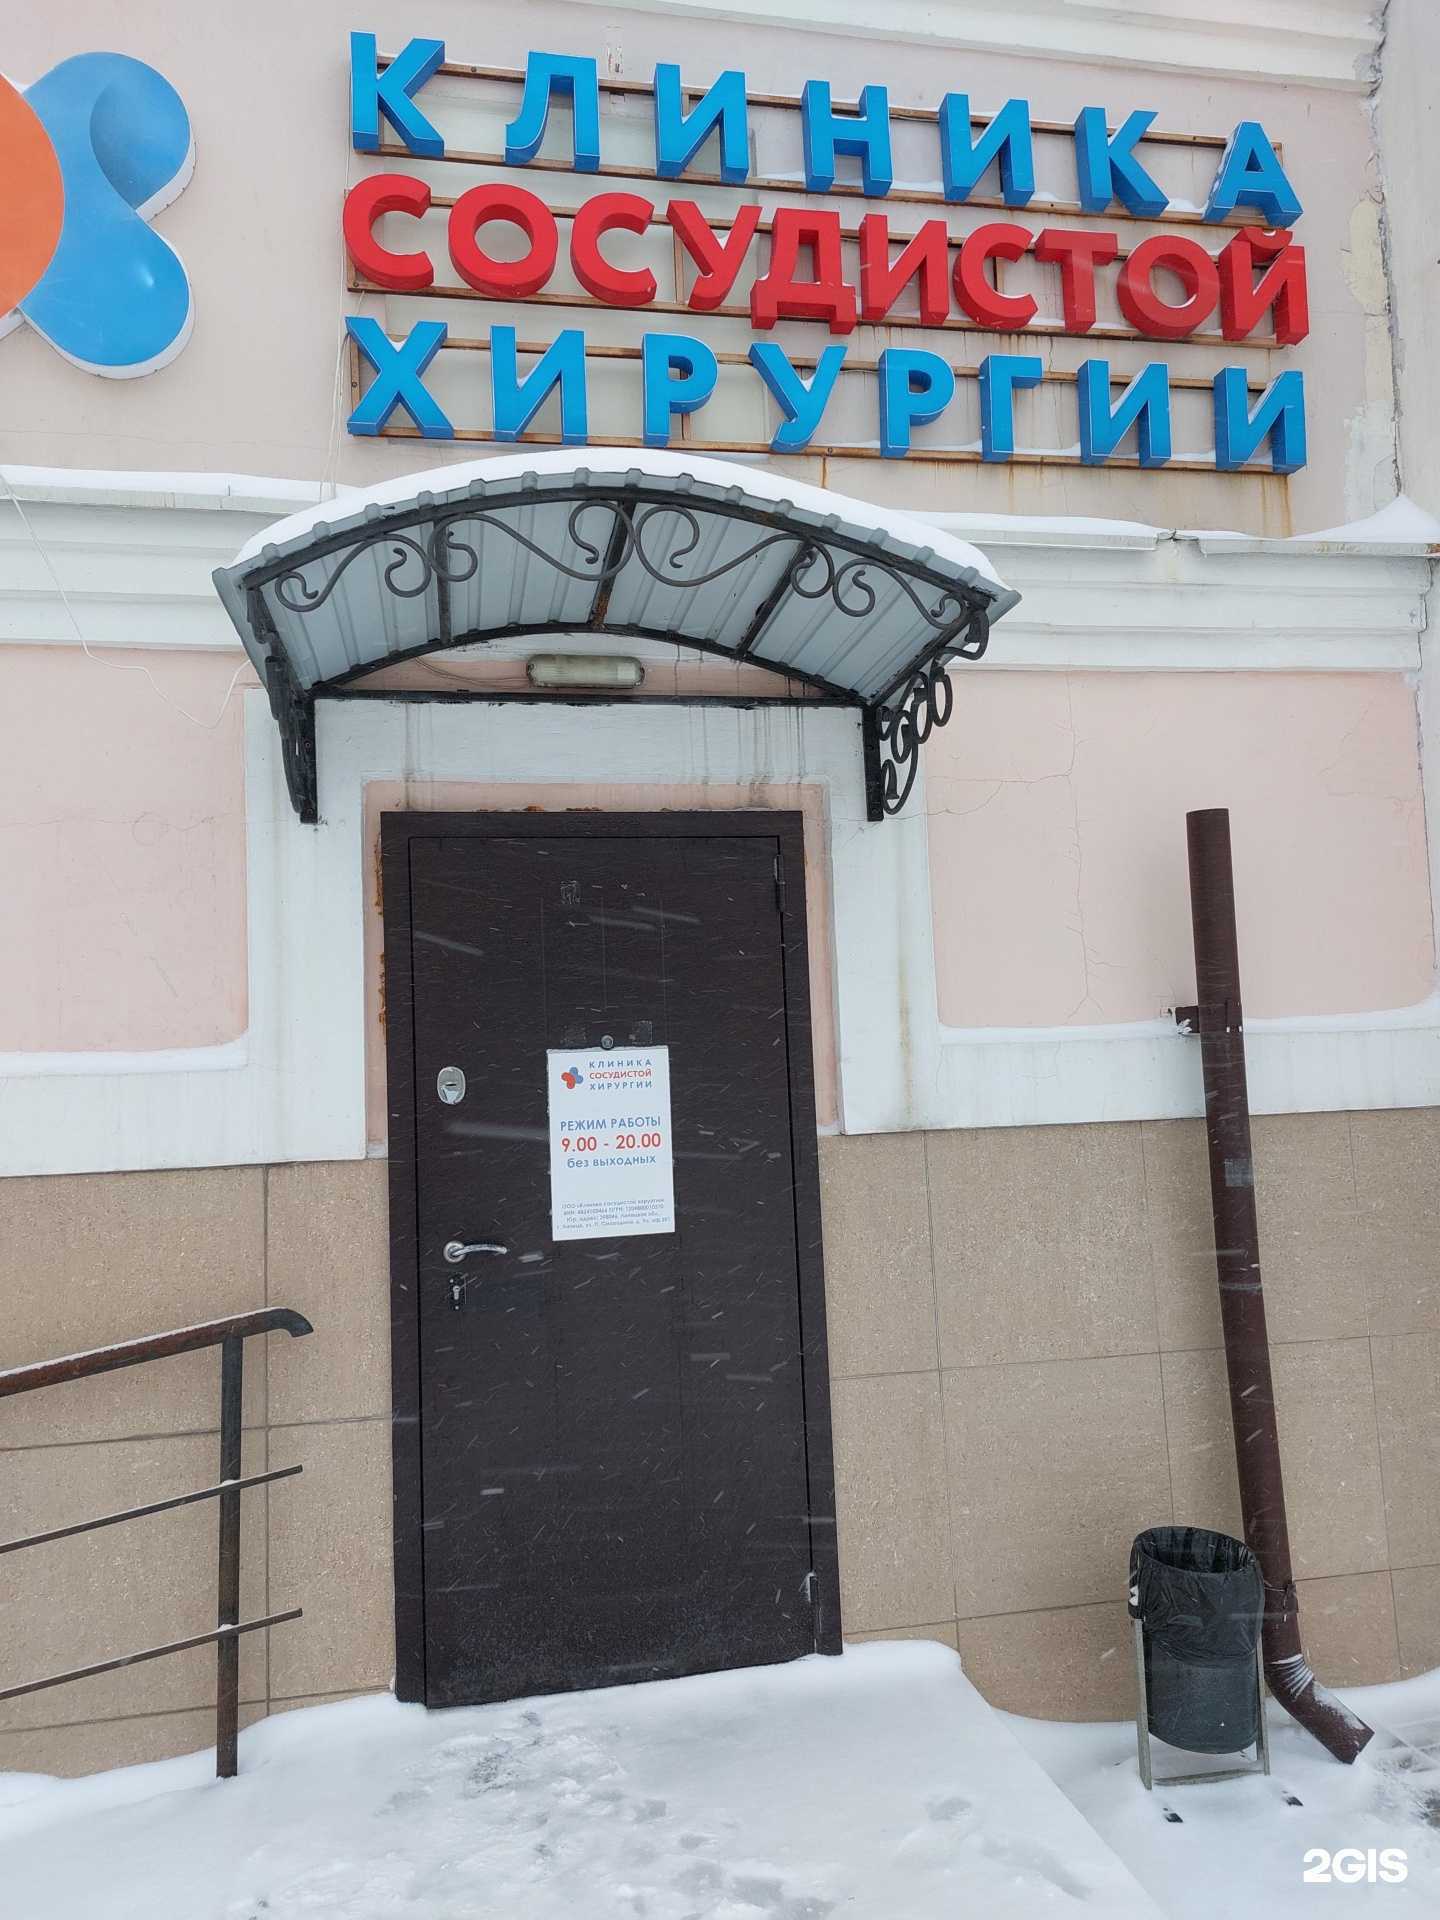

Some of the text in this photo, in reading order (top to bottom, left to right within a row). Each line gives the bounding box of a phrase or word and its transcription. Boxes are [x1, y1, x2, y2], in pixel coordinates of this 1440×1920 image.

[350, 31, 1301, 229] КЛИНИКА
[343, 173, 1309, 346] СОСУДИСТОЙ
[345, 316, 1306, 474] ХИРУРГИИ
[589, 1058, 653, 1069] КЛИНИКА
[589, 1068, 652, 1080] СОСУДИСТОЙ
[589, 1080, 653, 1091] ХИРУРГИИ
[560, 1115, 661, 1131] РЕЖИМ РАБОТЫ
[561, 1136, 597, 1152] 9.00
[615, 1132, 662, 1150] 20.00
[567, 1155, 656, 1168] без выходных
